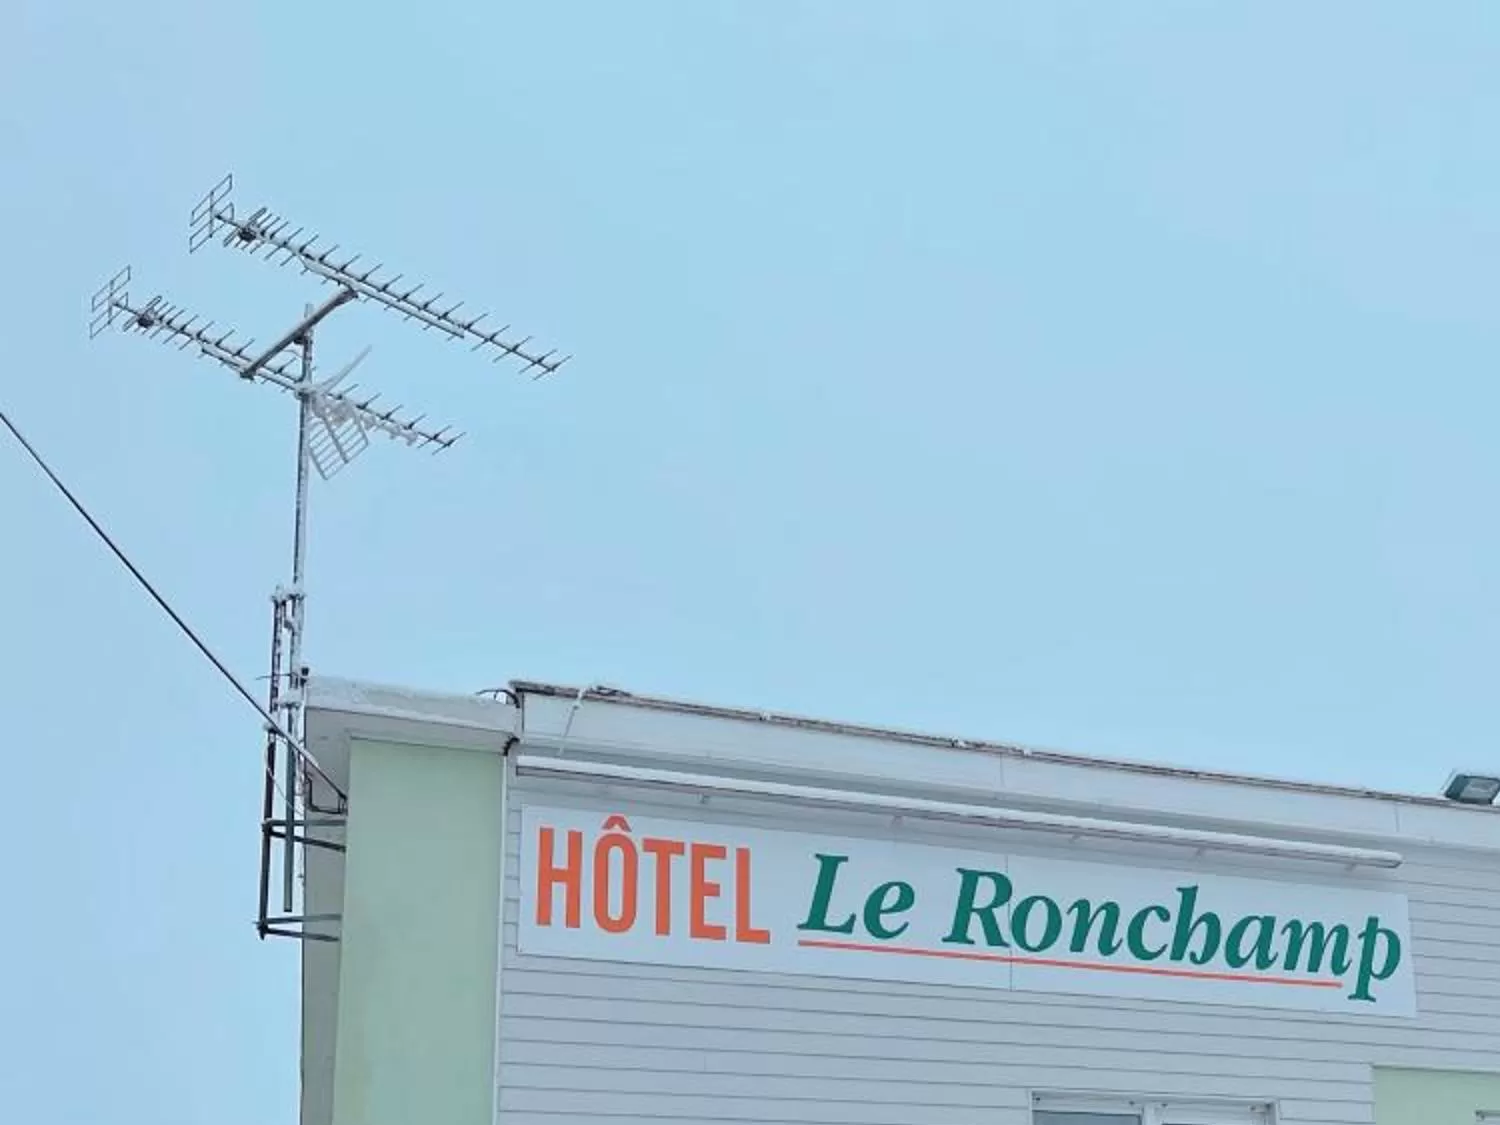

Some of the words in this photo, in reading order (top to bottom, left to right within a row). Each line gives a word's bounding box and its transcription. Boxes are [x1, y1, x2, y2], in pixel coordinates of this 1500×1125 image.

[536, 815, 770, 943] HÔTEL
[798, 853, 915, 941] Le
[942, 868, 1401, 1003] Ronchamp
